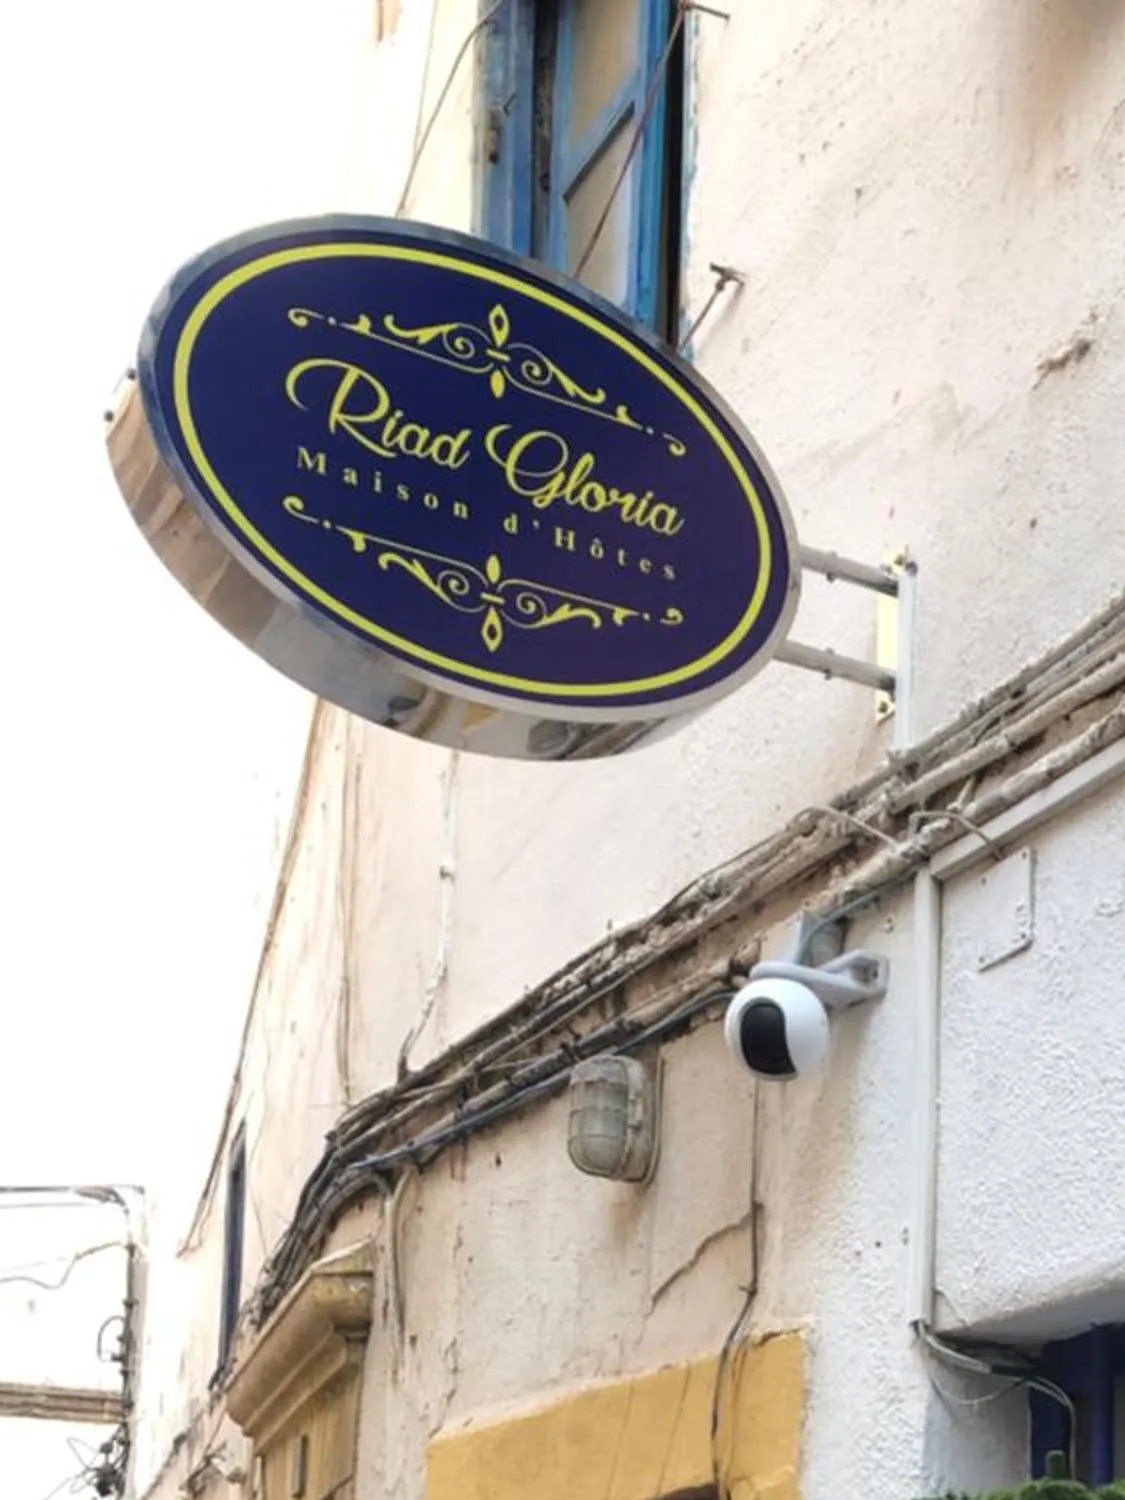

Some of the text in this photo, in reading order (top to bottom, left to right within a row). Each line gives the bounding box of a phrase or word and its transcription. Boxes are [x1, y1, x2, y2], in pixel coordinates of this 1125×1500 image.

[286, 358, 685, 536] Riad Gloria
[297, 447, 676, 581] Maison d'Hôtes
